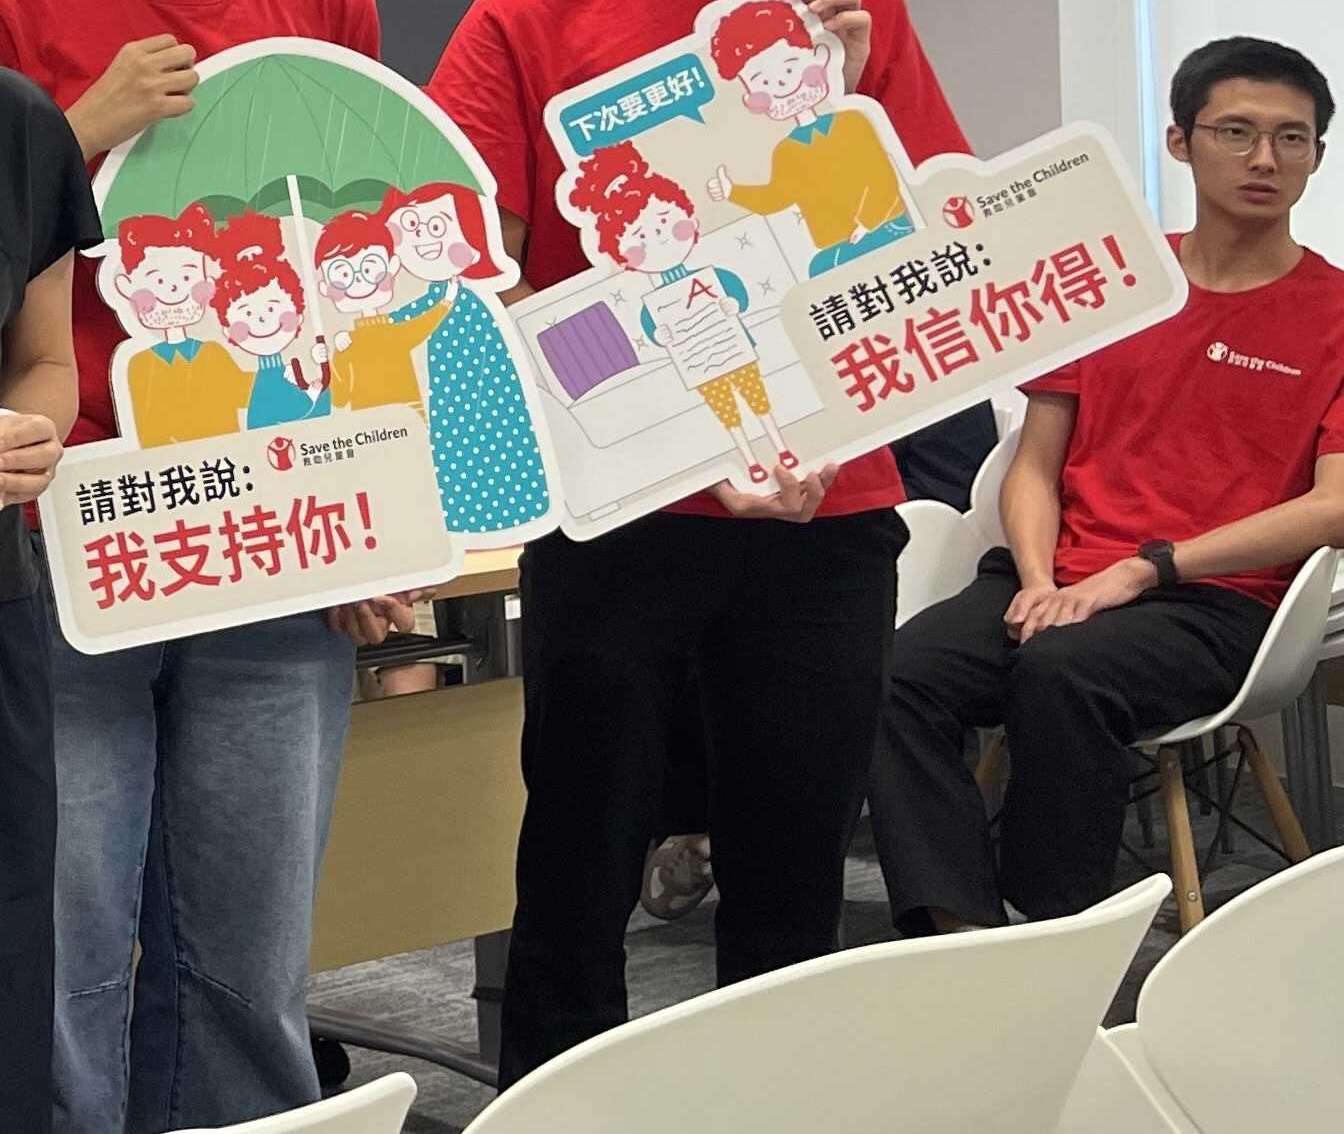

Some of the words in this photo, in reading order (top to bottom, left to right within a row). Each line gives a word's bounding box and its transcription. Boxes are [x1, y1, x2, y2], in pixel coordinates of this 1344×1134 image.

[568, 67, 705, 142] 下次要更好!
[976, 188, 1009, 209] Save
[1009, 178, 1033, 194] the
[1032, 153, 1090, 183] Children
[830, 234, 1137, 412] 我信你得!
[300, 442, 330, 456] Save
[332, 436, 353, 451] the
[354, 427, 408, 446] Children
[82, 491, 377, 610] 我支持你!
